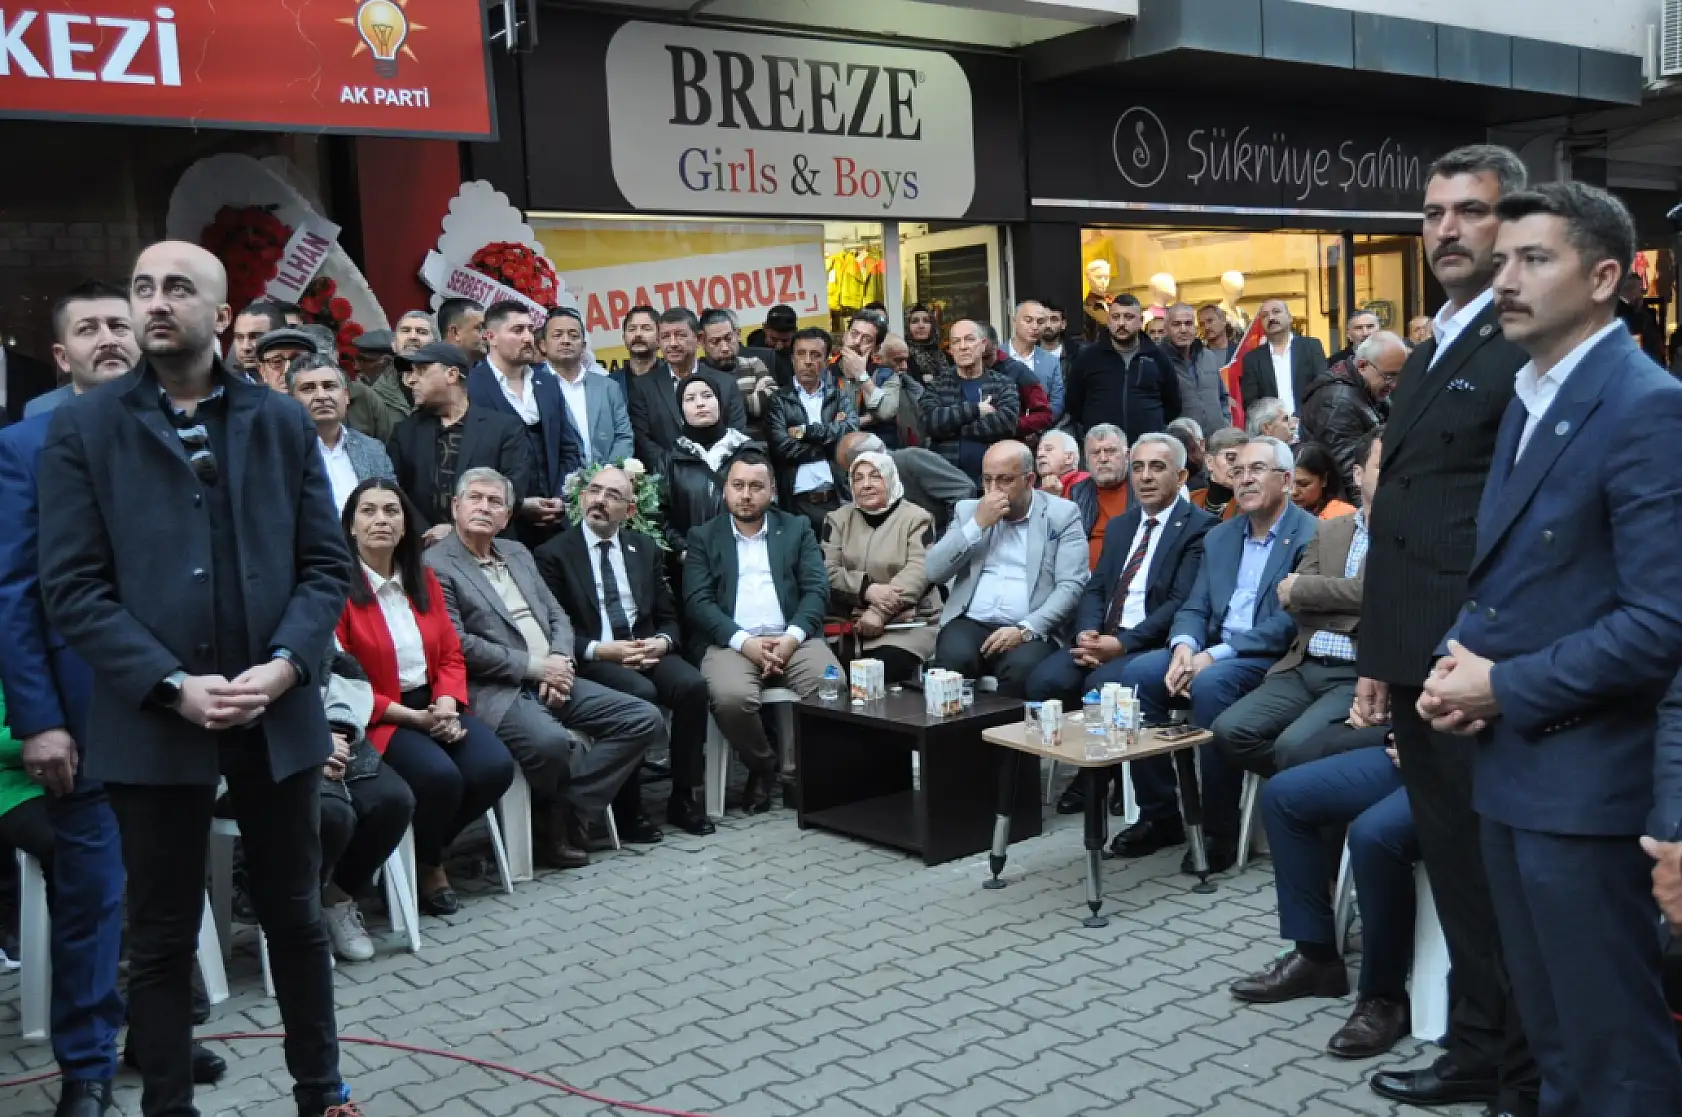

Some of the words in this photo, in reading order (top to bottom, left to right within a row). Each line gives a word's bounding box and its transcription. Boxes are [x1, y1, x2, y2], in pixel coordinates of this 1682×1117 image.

[0, 7, 182, 87] KEZİ
[340, 85, 369, 104] AK
[373, 85, 430, 108] PARTİ
[664, 44, 922, 141] BREEZE
[679, 147, 778, 195] Girls
[790, 154, 822, 196] &
[833, 157, 919, 208] Boys
[1187, 126, 1330, 201] Şükrüye
